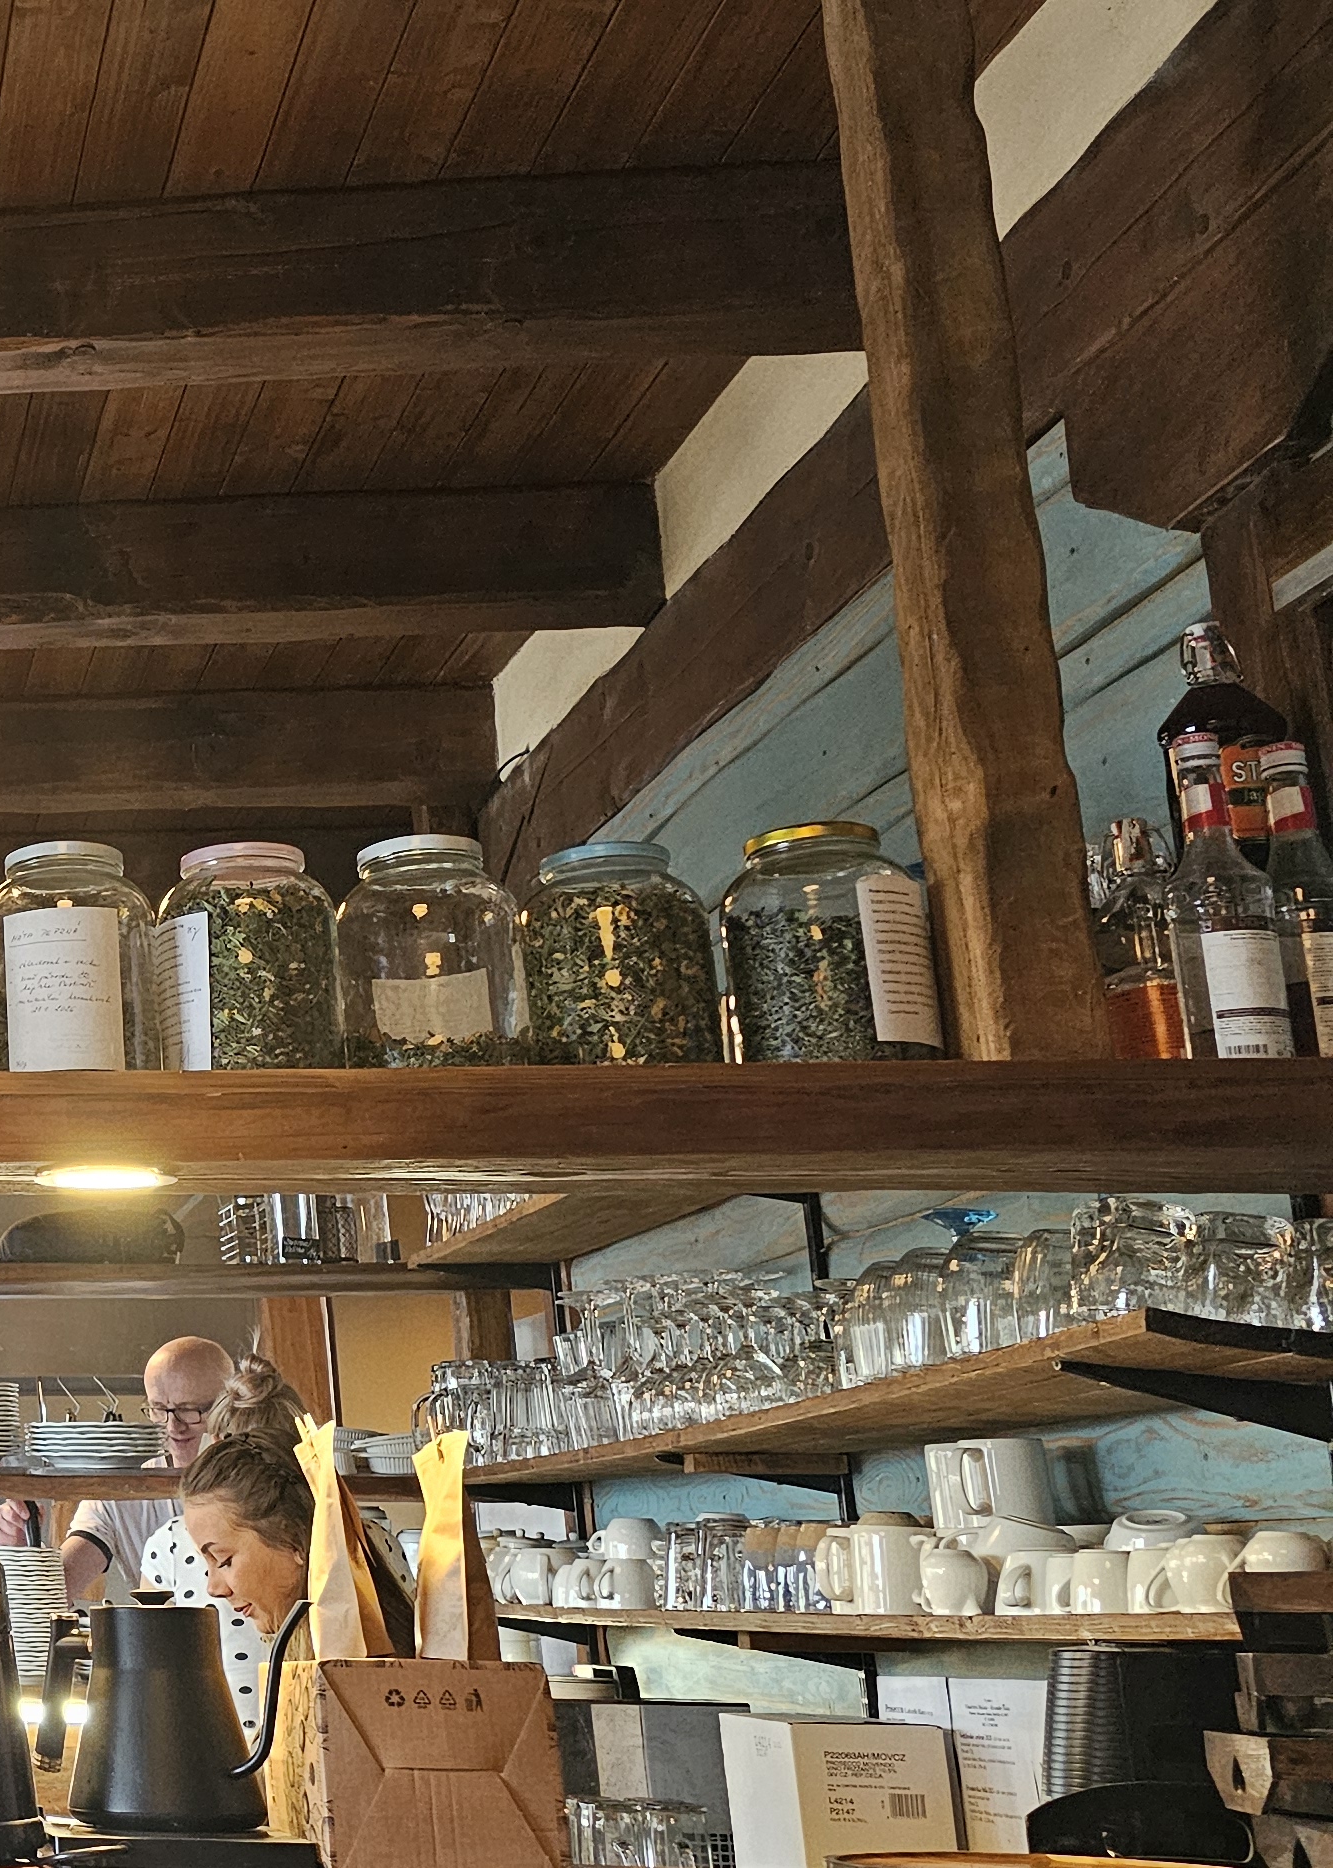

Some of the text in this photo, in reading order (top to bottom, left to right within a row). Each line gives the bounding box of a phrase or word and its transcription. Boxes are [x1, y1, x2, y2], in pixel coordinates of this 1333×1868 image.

[1232, 761, 1259, 782] ST
[828, 1797, 854, 1805] L4214
[829, 1807, 855, 1815] P2147
